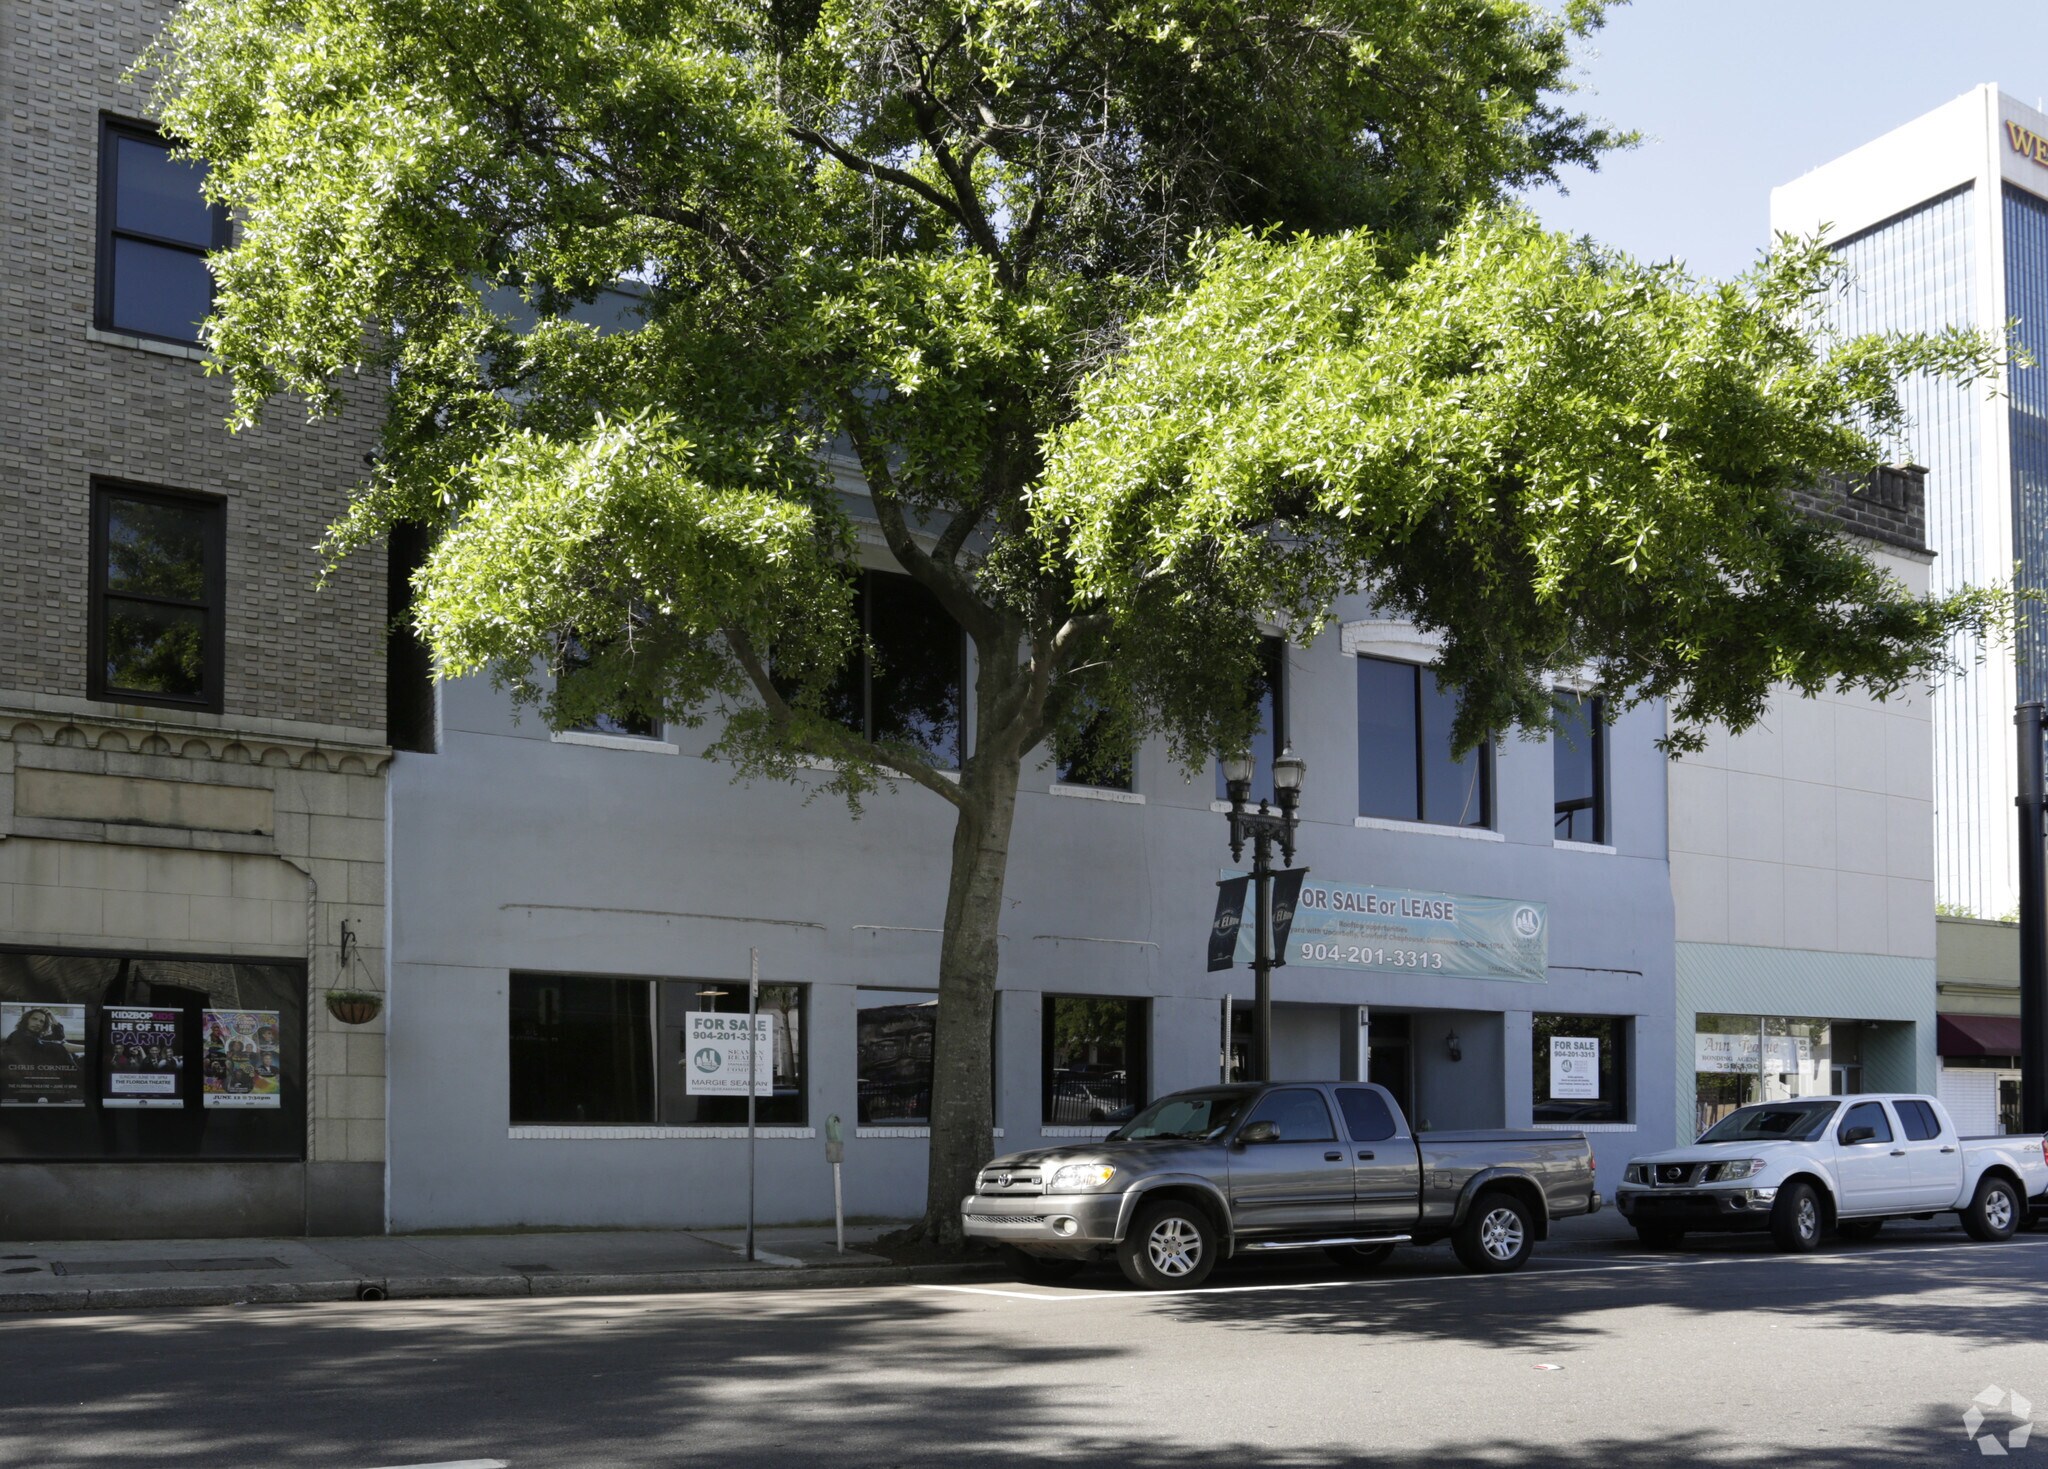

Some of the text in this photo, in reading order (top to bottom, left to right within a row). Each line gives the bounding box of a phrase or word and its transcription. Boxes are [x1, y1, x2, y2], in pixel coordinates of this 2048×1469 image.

[1301, 888, 1454, 921] OR SALE or LEASE
[1301, 942, 1443, 969] 904-201-3313
[111, 1022, 175, 1032] LIFE OF THE
[694, 1018, 767, 1032] FOR SAE
[110, 1031, 176, 1046] PARTY
[1554, 1041, 1595, 1051] FOR SALE
[1704, 1037, 1779, 1053] Ann Teaue
